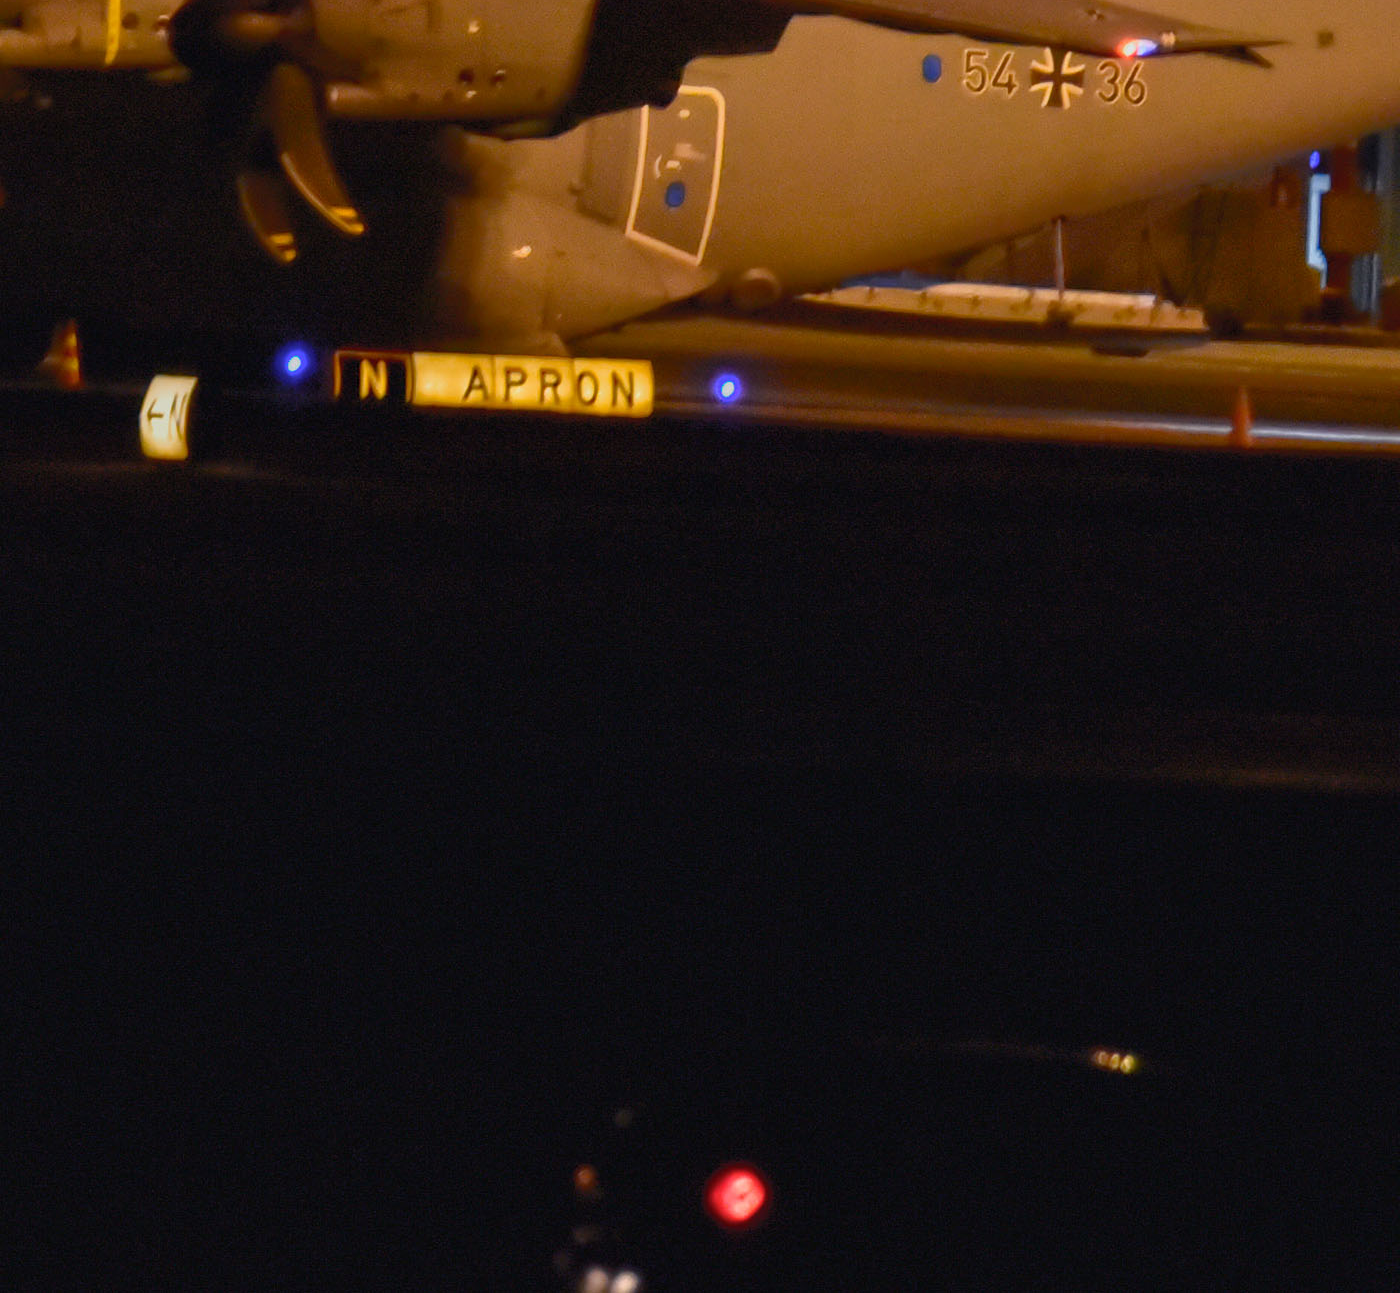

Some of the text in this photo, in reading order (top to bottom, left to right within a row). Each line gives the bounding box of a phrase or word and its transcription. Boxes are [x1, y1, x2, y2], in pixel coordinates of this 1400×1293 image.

[963, 47, 1147, 106] 54 36
[358, 357, 636, 408] N APRON
